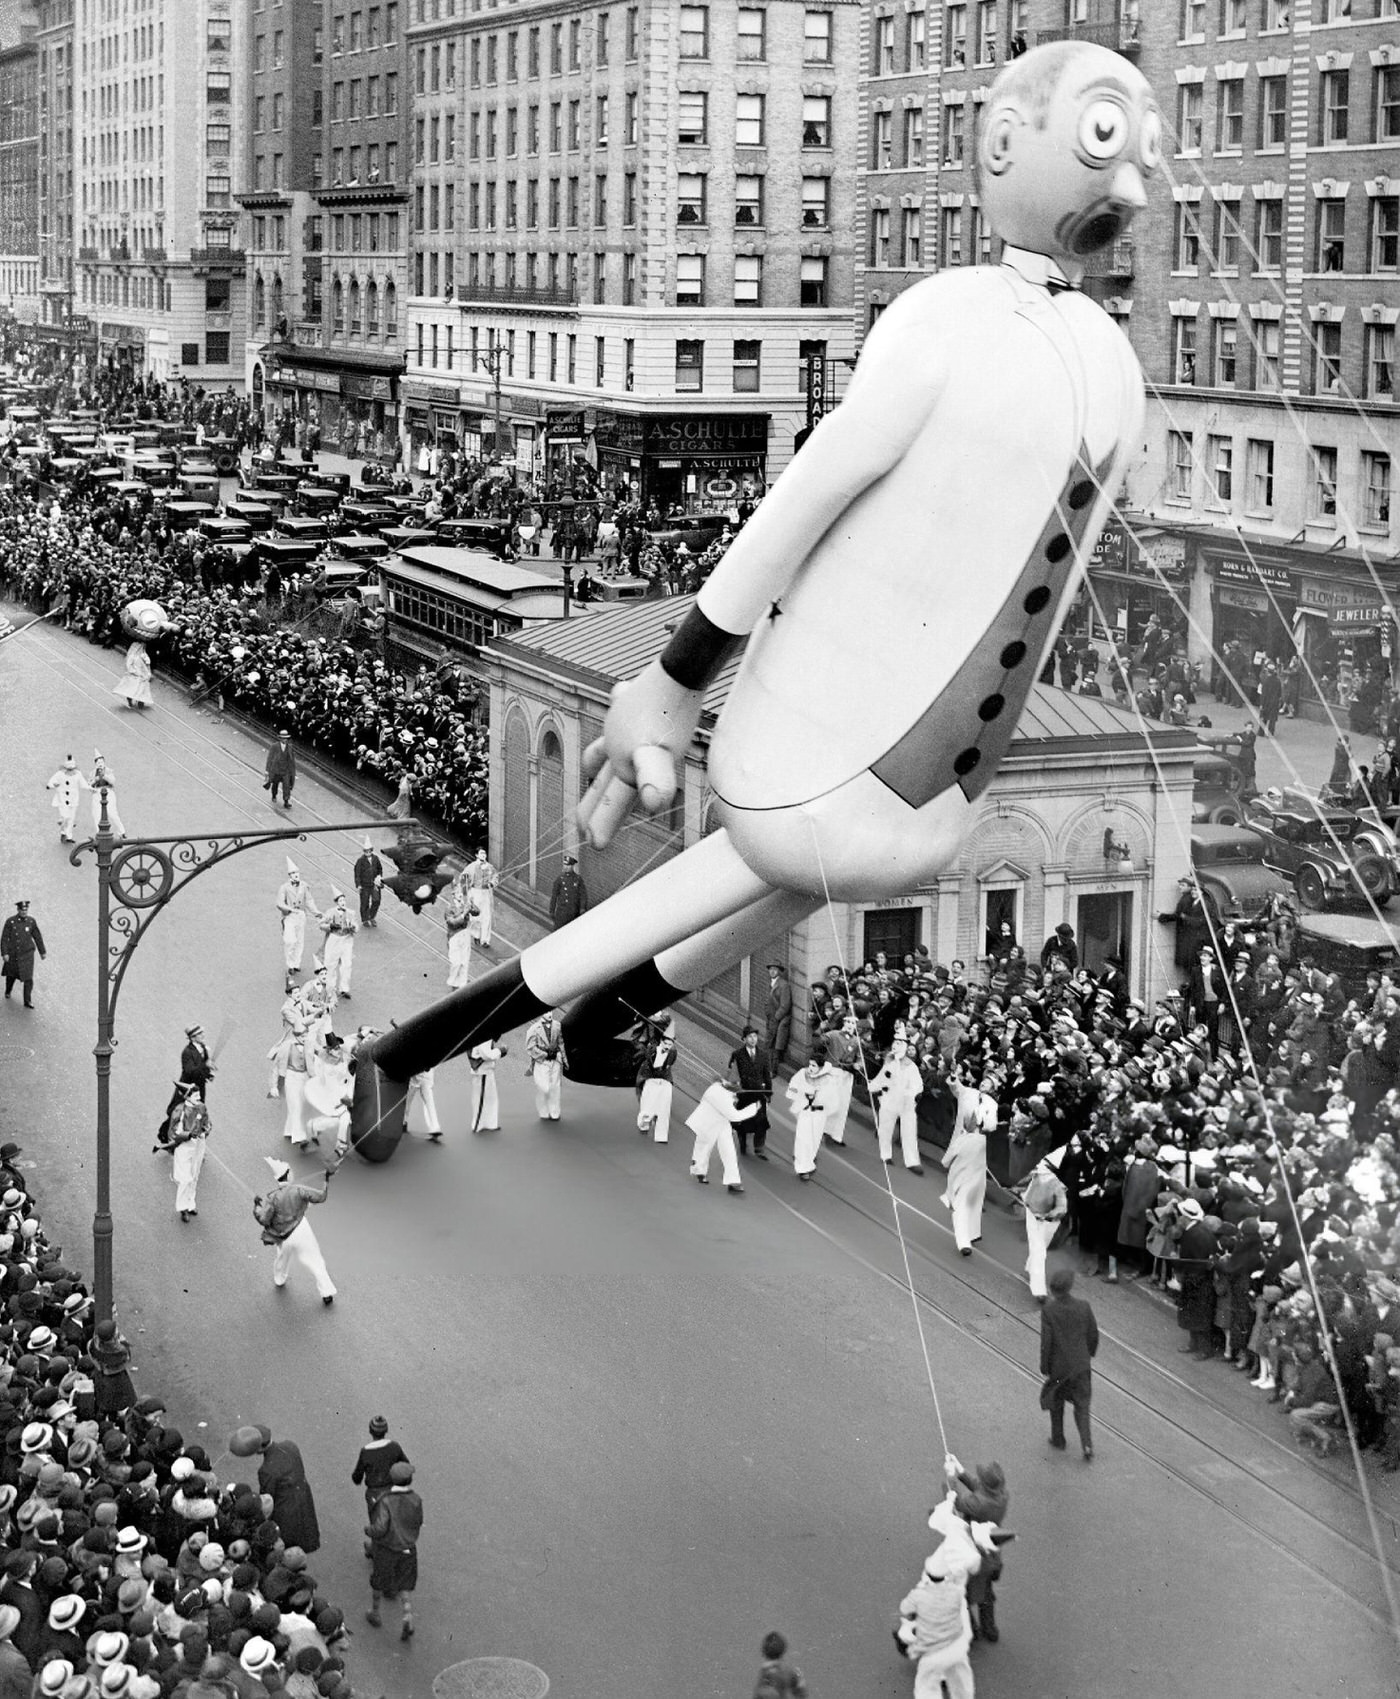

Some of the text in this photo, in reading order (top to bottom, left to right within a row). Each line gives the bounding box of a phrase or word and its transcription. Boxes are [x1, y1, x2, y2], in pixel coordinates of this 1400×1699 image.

[553, 425, 578, 433] CIGARS
[669, 440, 736, 451] CIGARS
[1333, 609, 1379, 621] JEWELER
